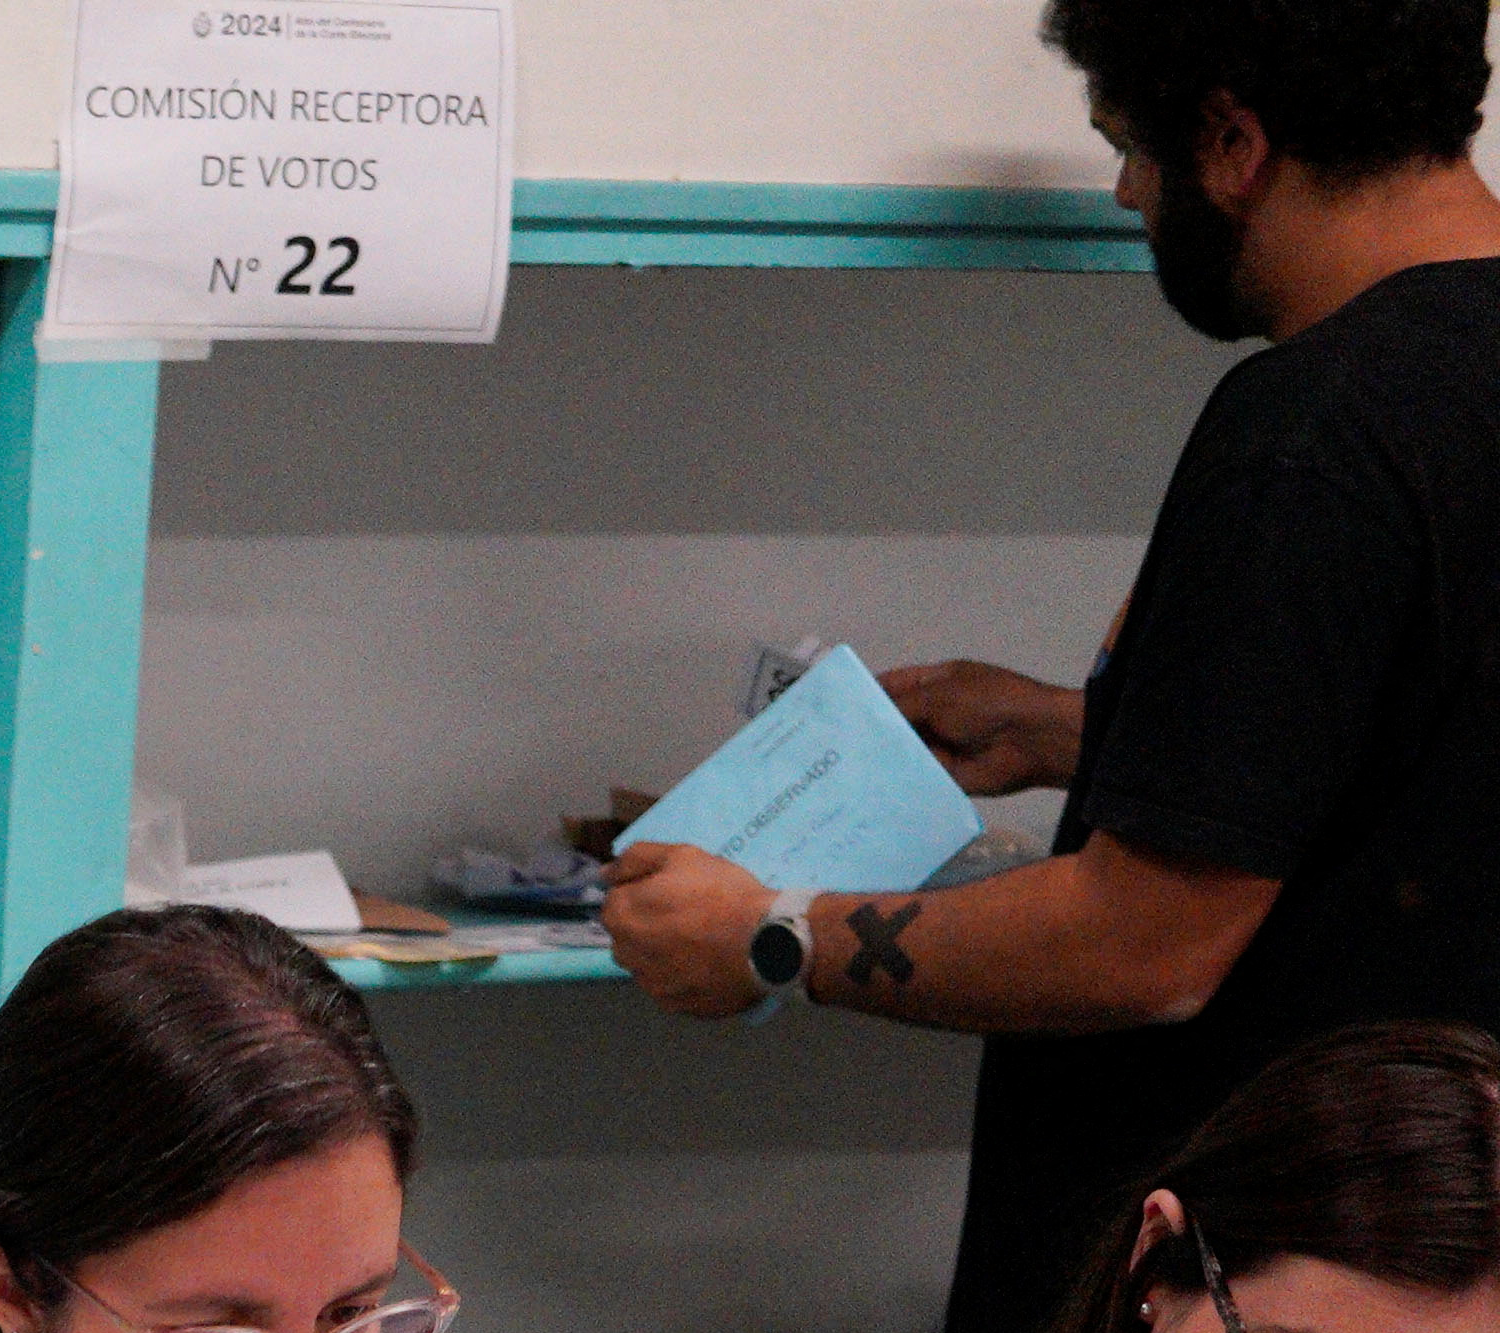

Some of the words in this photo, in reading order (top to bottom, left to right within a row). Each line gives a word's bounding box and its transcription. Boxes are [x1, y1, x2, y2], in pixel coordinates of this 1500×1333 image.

[221, 13, 281, 36] 2024
[86, 79, 276, 121] COMISIÓN
[290, 90, 490, 127] RECEPTORA
[200, 155, 245, 188] DE
[258, 157, 379, 191] VOTOS
[276, 236, 362, 296] 22
